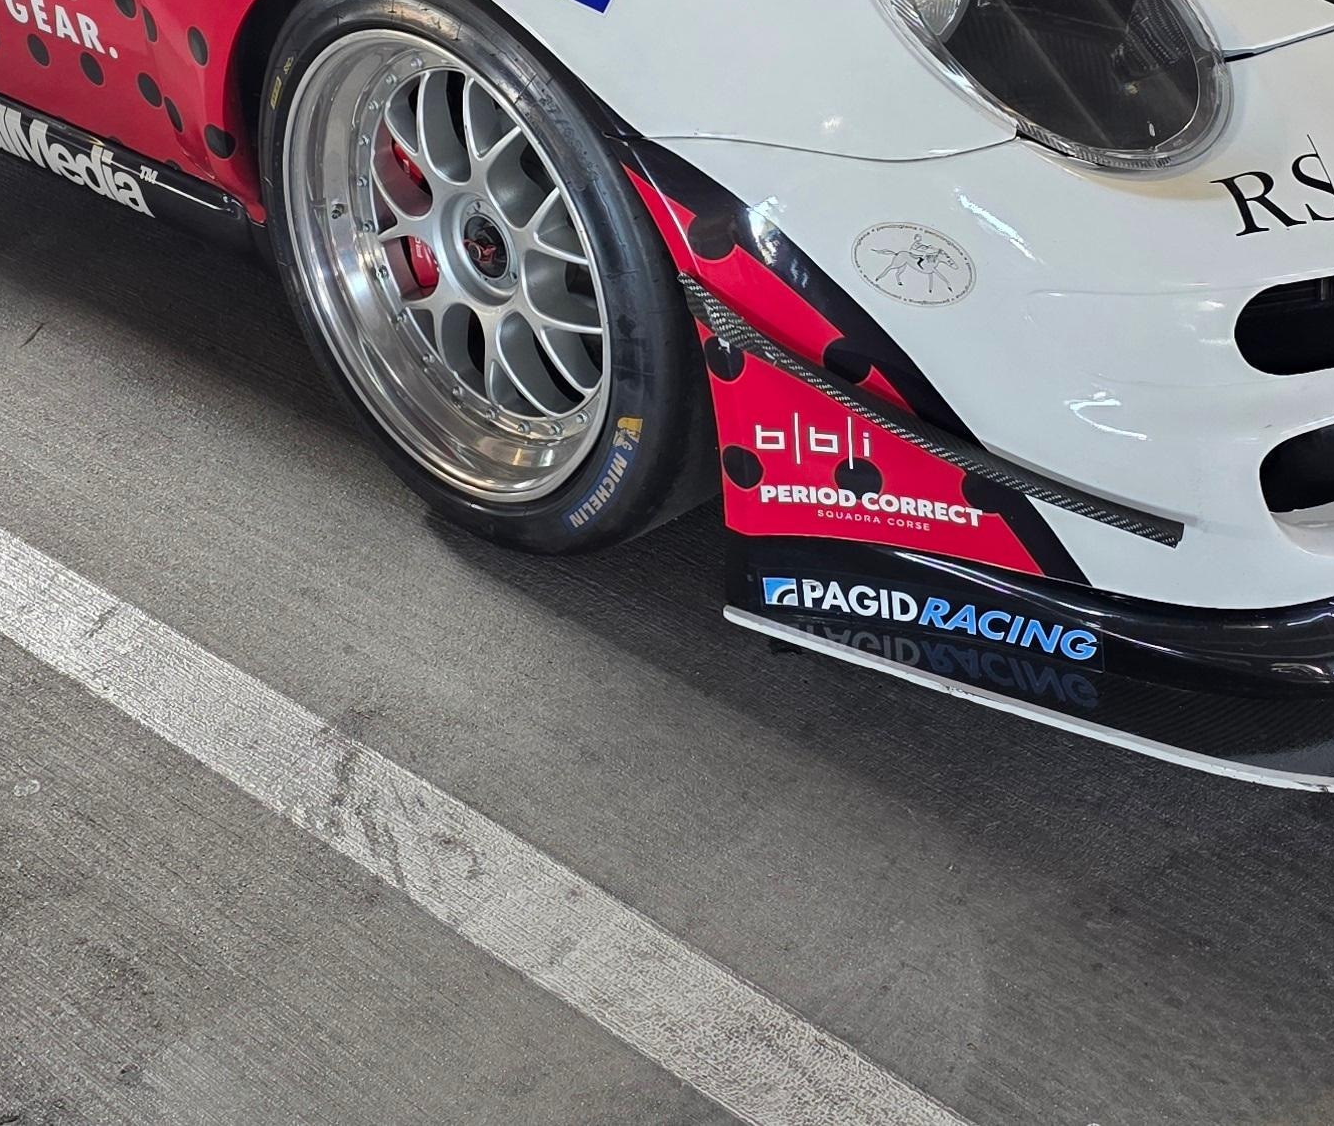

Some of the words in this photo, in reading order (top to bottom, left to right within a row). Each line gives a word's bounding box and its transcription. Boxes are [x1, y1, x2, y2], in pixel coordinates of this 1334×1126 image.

[568, 451, 628, 529] MICHELIN
[760, 484, 857, 508] PERIOD
[861, 491, 983, 528] CORRECT
[817, 508, 881, 525] SQUADRA
[887, 516, 931, 532] CORSE
